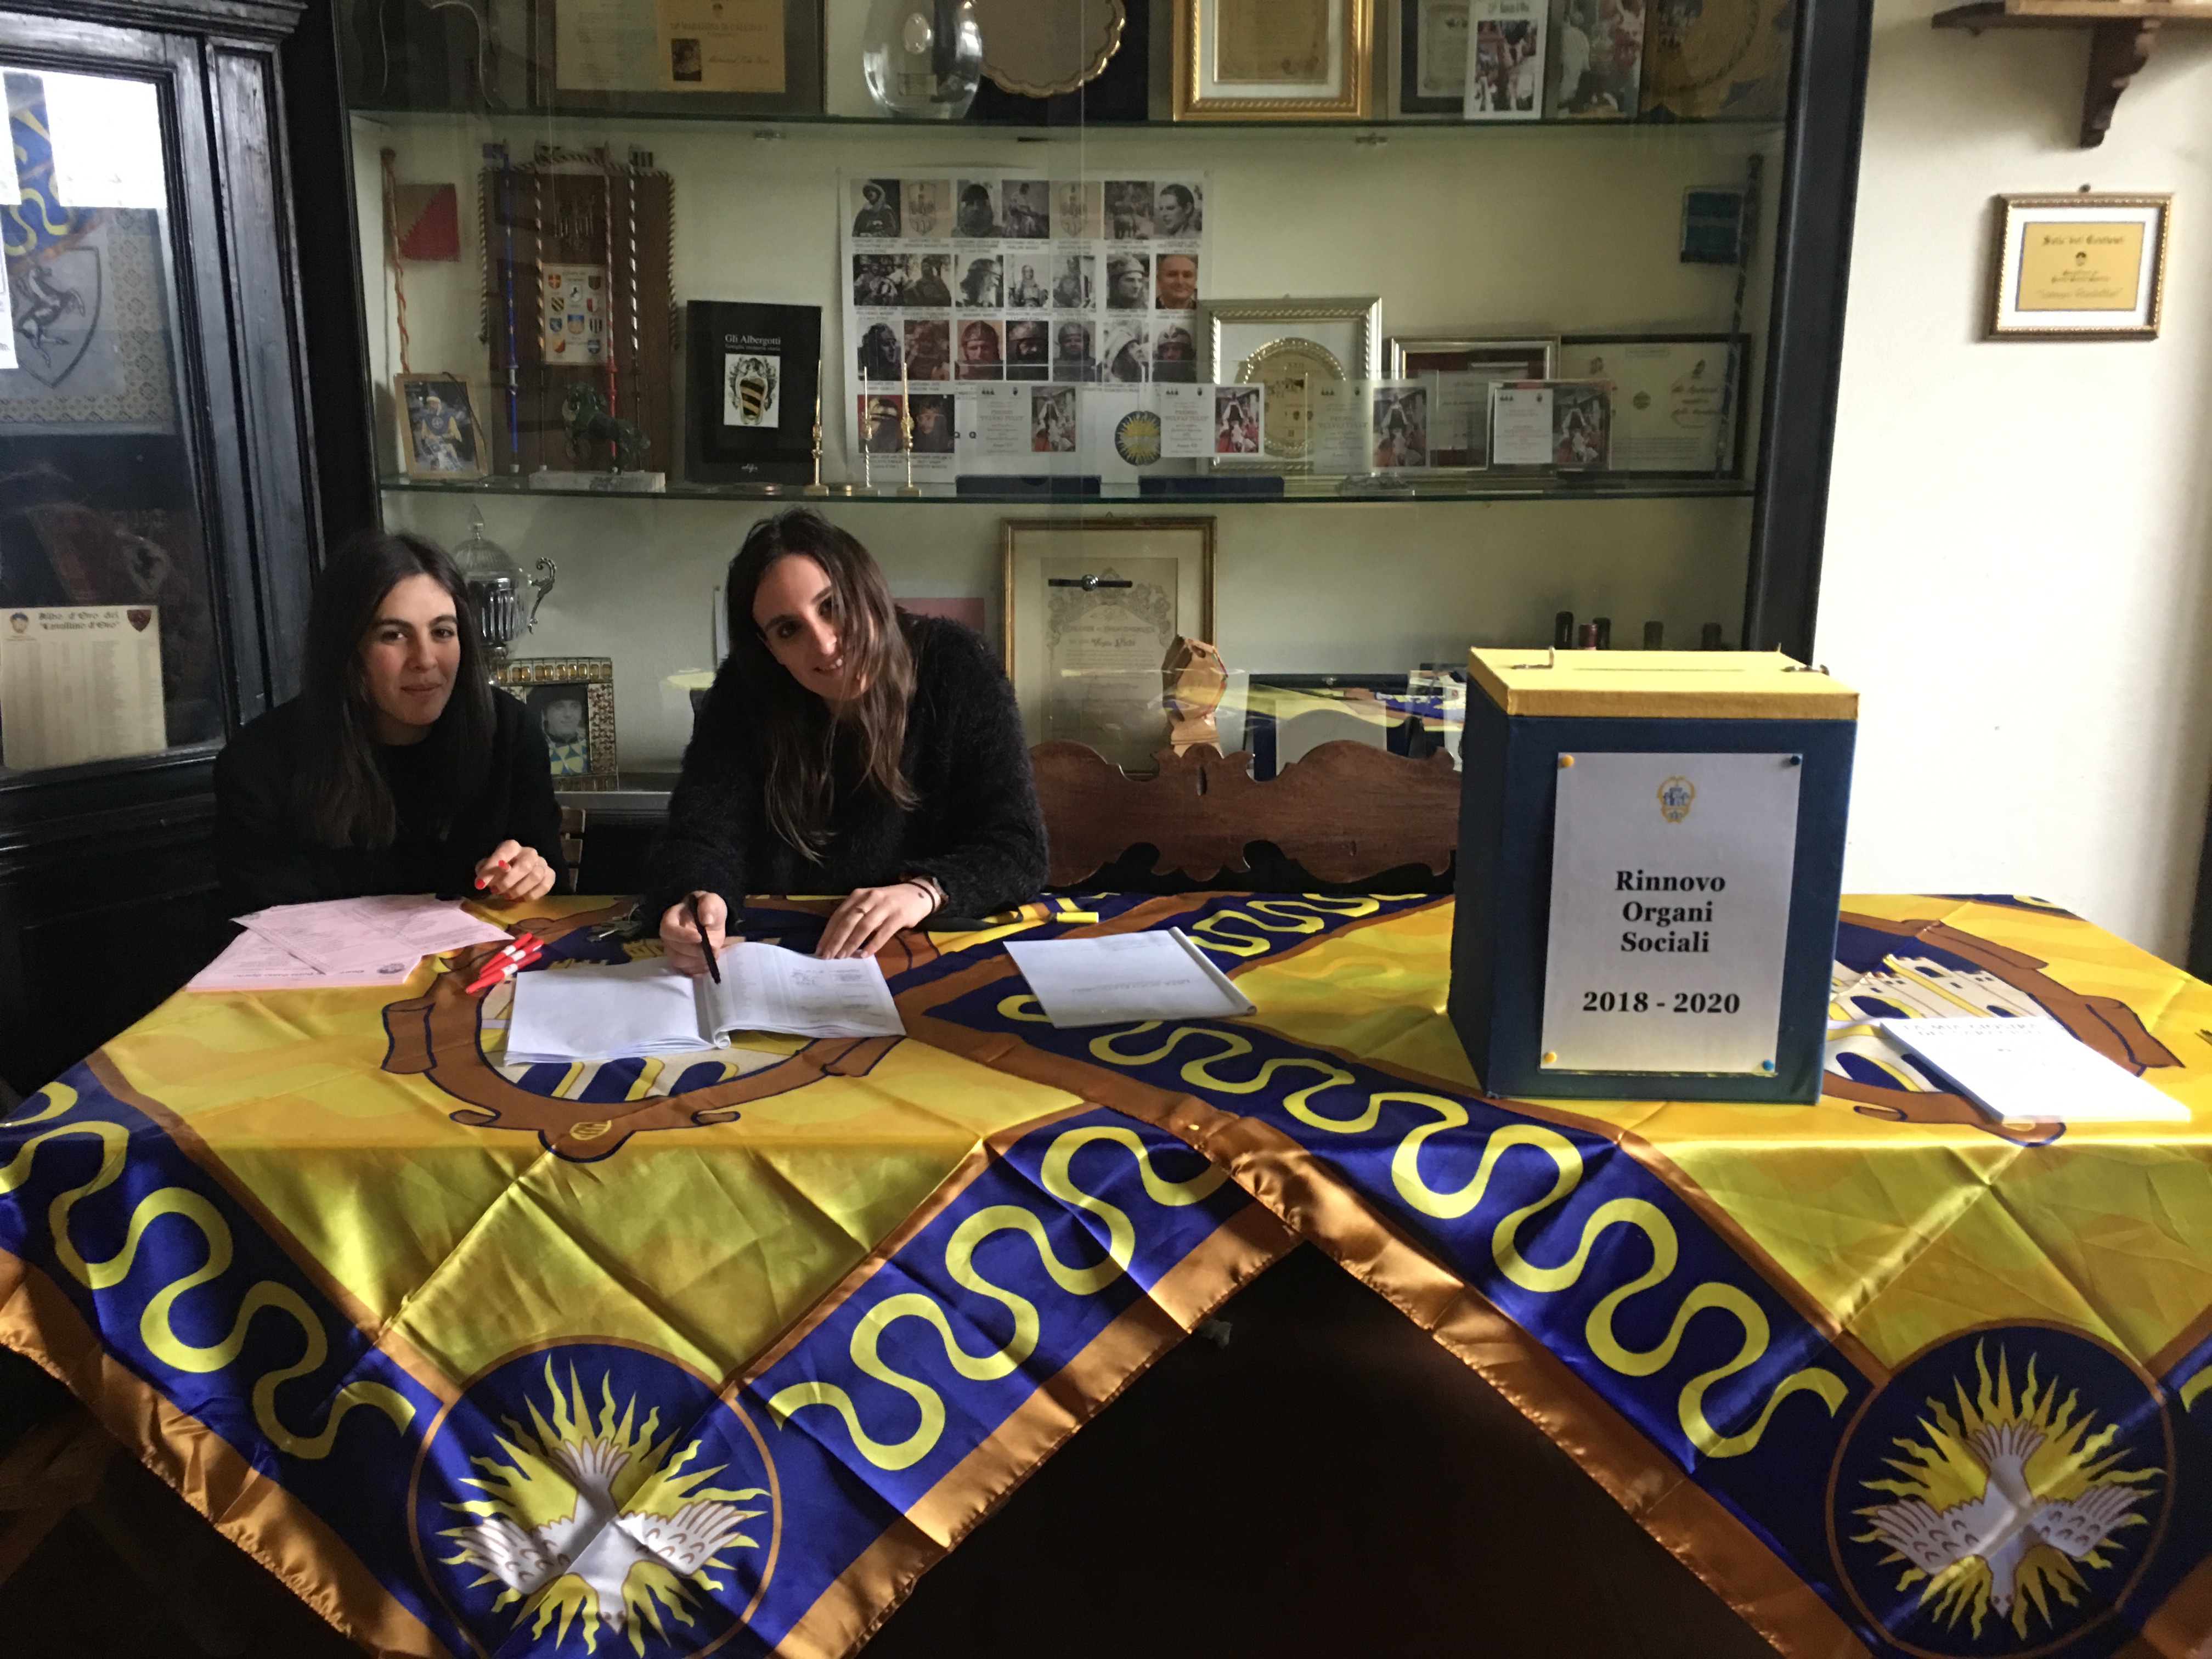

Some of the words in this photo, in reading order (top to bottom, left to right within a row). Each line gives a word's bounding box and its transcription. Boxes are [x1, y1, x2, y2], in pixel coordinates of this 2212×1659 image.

[725, 334, 738, 343] Gli
[740, 335, 781, 346] Albergotti
[1615, 869, 1726, 892] Rinnovo
[1622, 900, 1713, 928] Organi
[1621, 930, 1709, 953] Sociali
[1583, 991, 1648, 1012] 2018
[1673, 993, 1740, 1014] 2020
